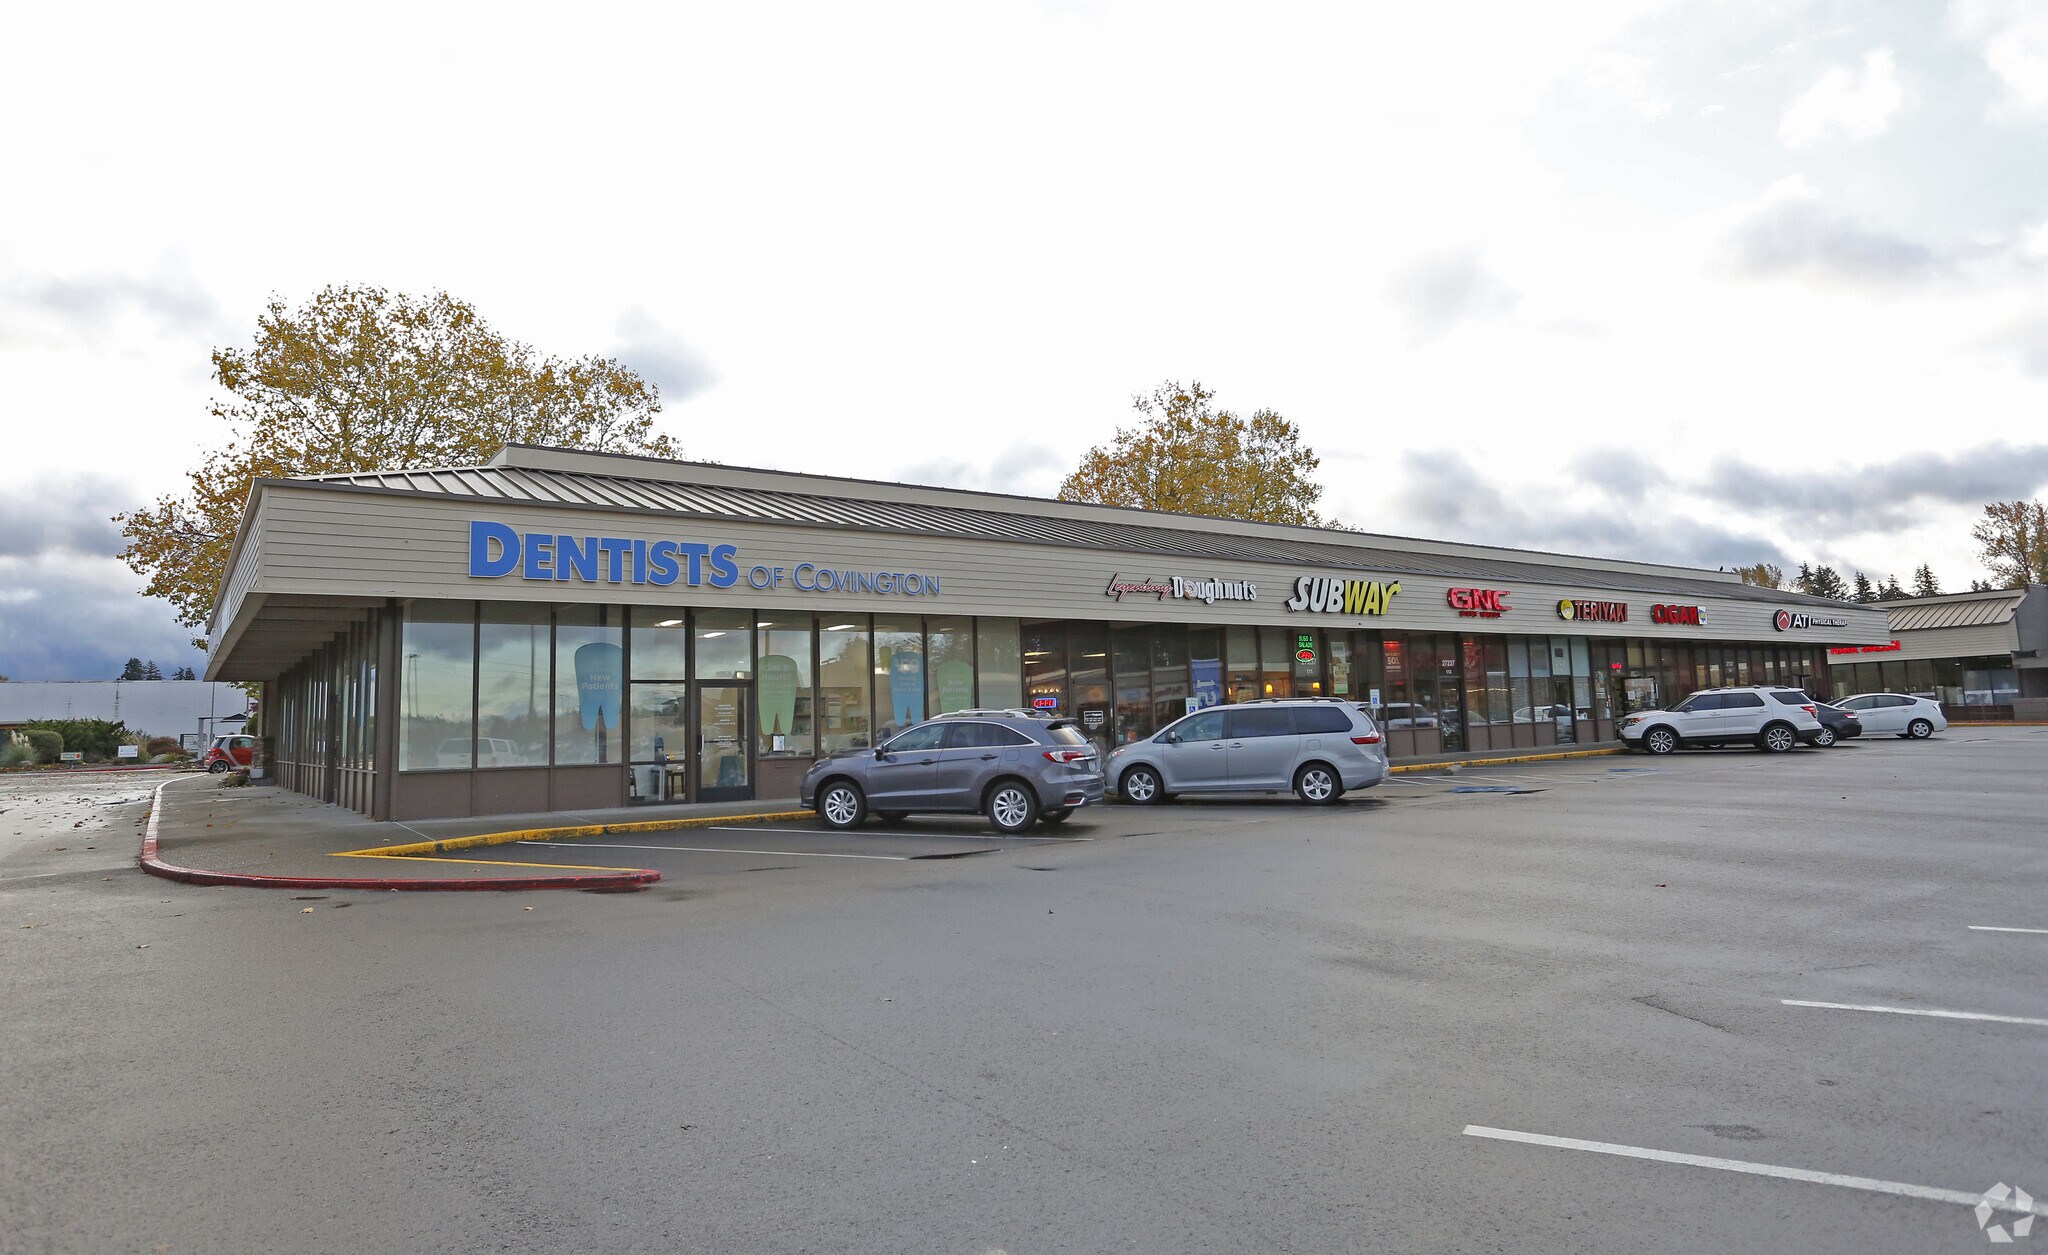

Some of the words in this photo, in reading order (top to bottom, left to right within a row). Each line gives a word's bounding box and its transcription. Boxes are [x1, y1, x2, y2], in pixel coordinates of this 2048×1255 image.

[469, 520, 739, 588] DENTISTS
[748, 565, 784, 590] OF
[793, 562, 941, 596] COVINGTON
[1107, 573, 1173, 601] Legendary
[1171, 576, 1257, 604] Doughnuts
[1286, 576, 1403, 615] SUBWAY
[1448, 587, 1513, 611] GNC
[1574, 600, 1629, 622] TERIYAKI
[1652, 604, 1700, 625] CIGAR
[1793, 614, 1812, 628] ATI
[1812, 618, 1831, 626] PHYSICAL
[1832, 619, 1849, 627] THERAPY
[582, 682, 619, 690] Patients
